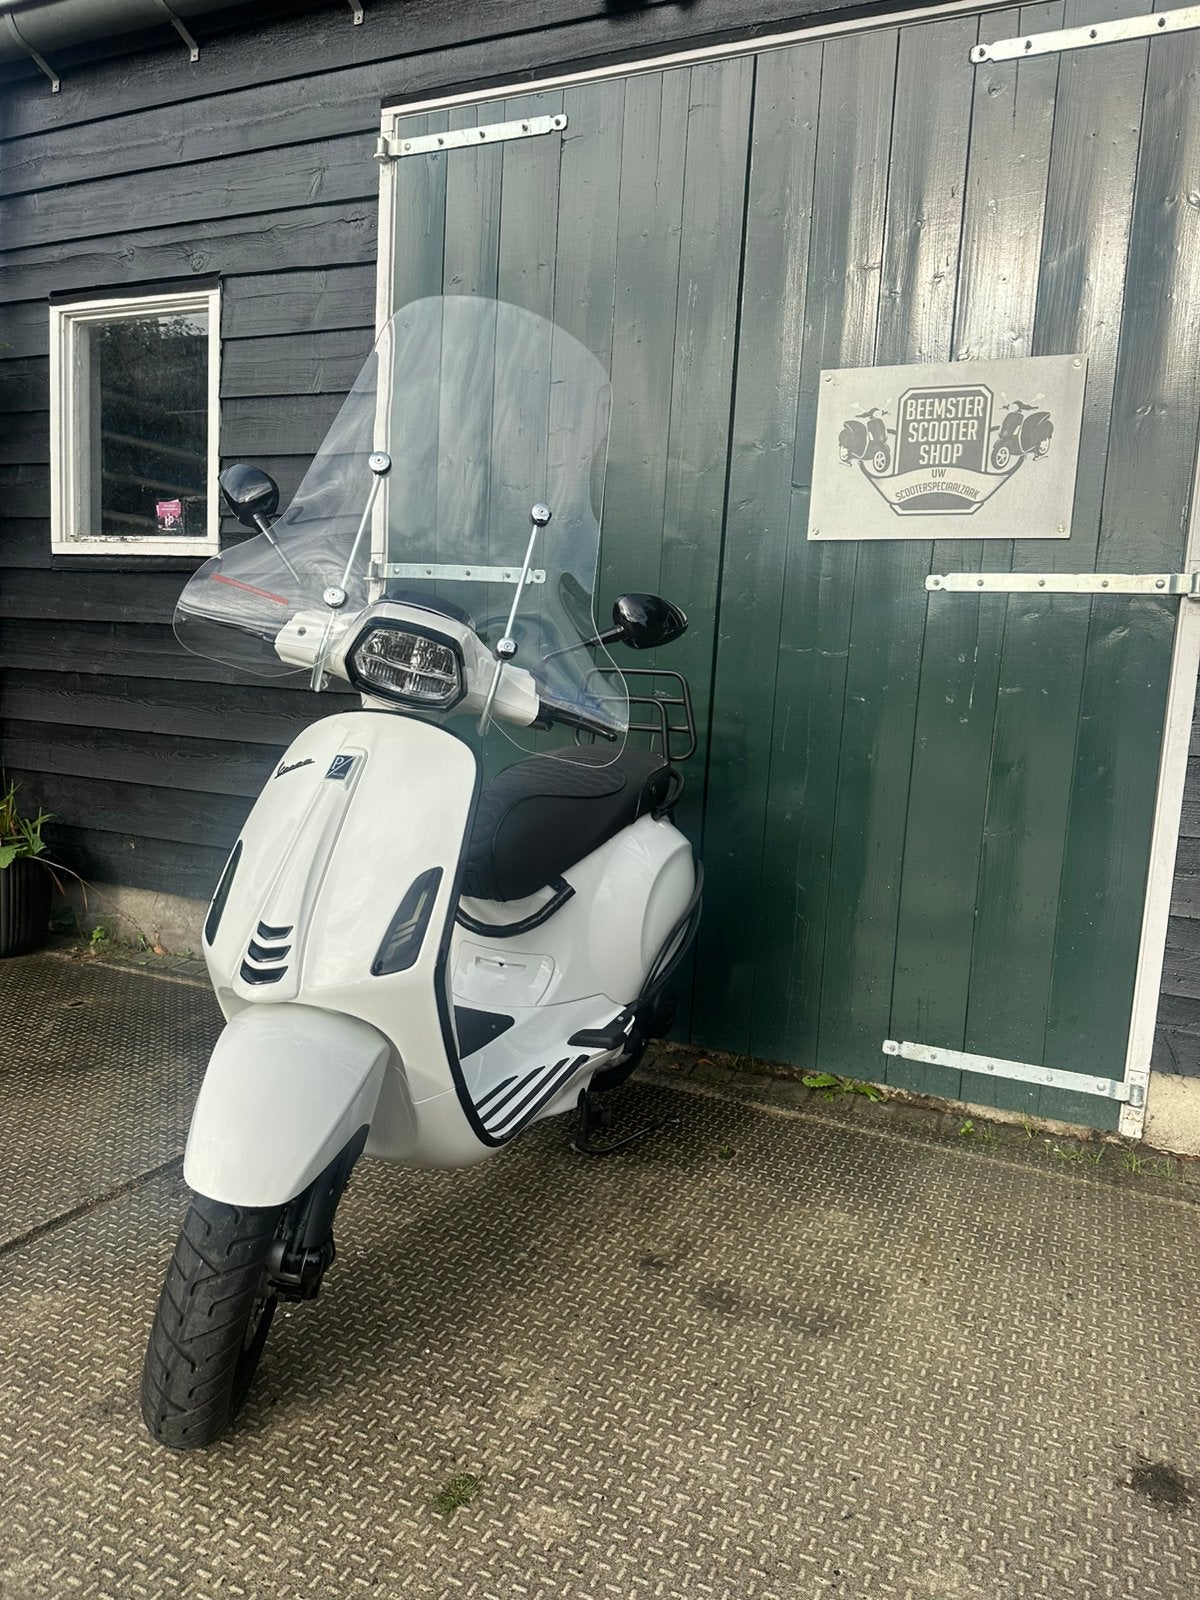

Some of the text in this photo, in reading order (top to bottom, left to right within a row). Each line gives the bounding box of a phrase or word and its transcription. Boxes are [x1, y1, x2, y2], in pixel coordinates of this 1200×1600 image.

[906, 396, 983, 420] BEEMSTER
[908, 419, 977, 442] SCOOTER
[919, 443, 962, 465] SHOP
[931, 468, 946, 478] UW
[895, 481, 980, 501] SCOOTERSPECIAALZAAK
